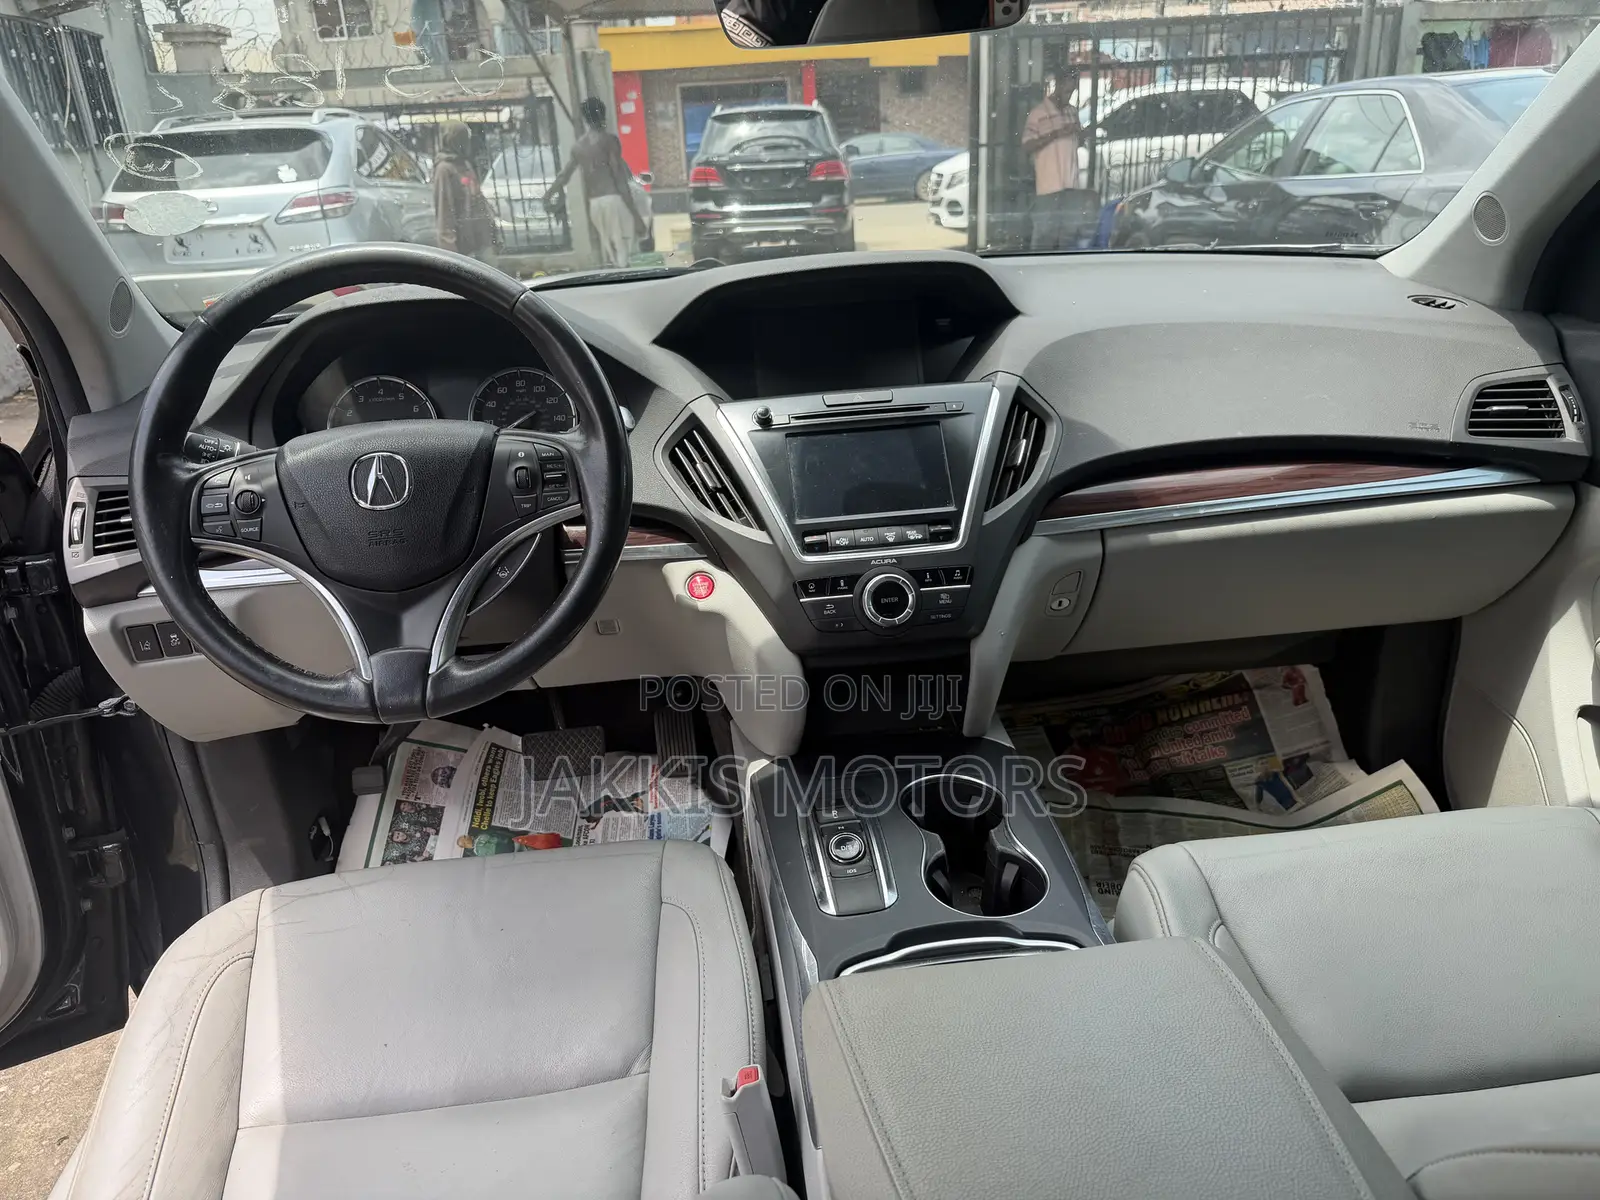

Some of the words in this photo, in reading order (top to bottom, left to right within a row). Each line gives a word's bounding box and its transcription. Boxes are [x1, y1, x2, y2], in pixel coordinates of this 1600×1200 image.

[515, 379, 526, 387] 80
[497, 386, 508, 394] 60
[358, 395, 364, 403] 3
[398, 392, 405, 400] 5
[485, 400, 497, 408] 40
[198, 443, 214, 452] AUTO
[880, 596, 899, 604] ENTER
[1183, 704, 1252, 734] committed
[1159, 732, 1202, 756] United
[1202, 726, 1236, 749] amid
[1193, 745, 1228, 764] talks
[832, 810, 838, 819] R
